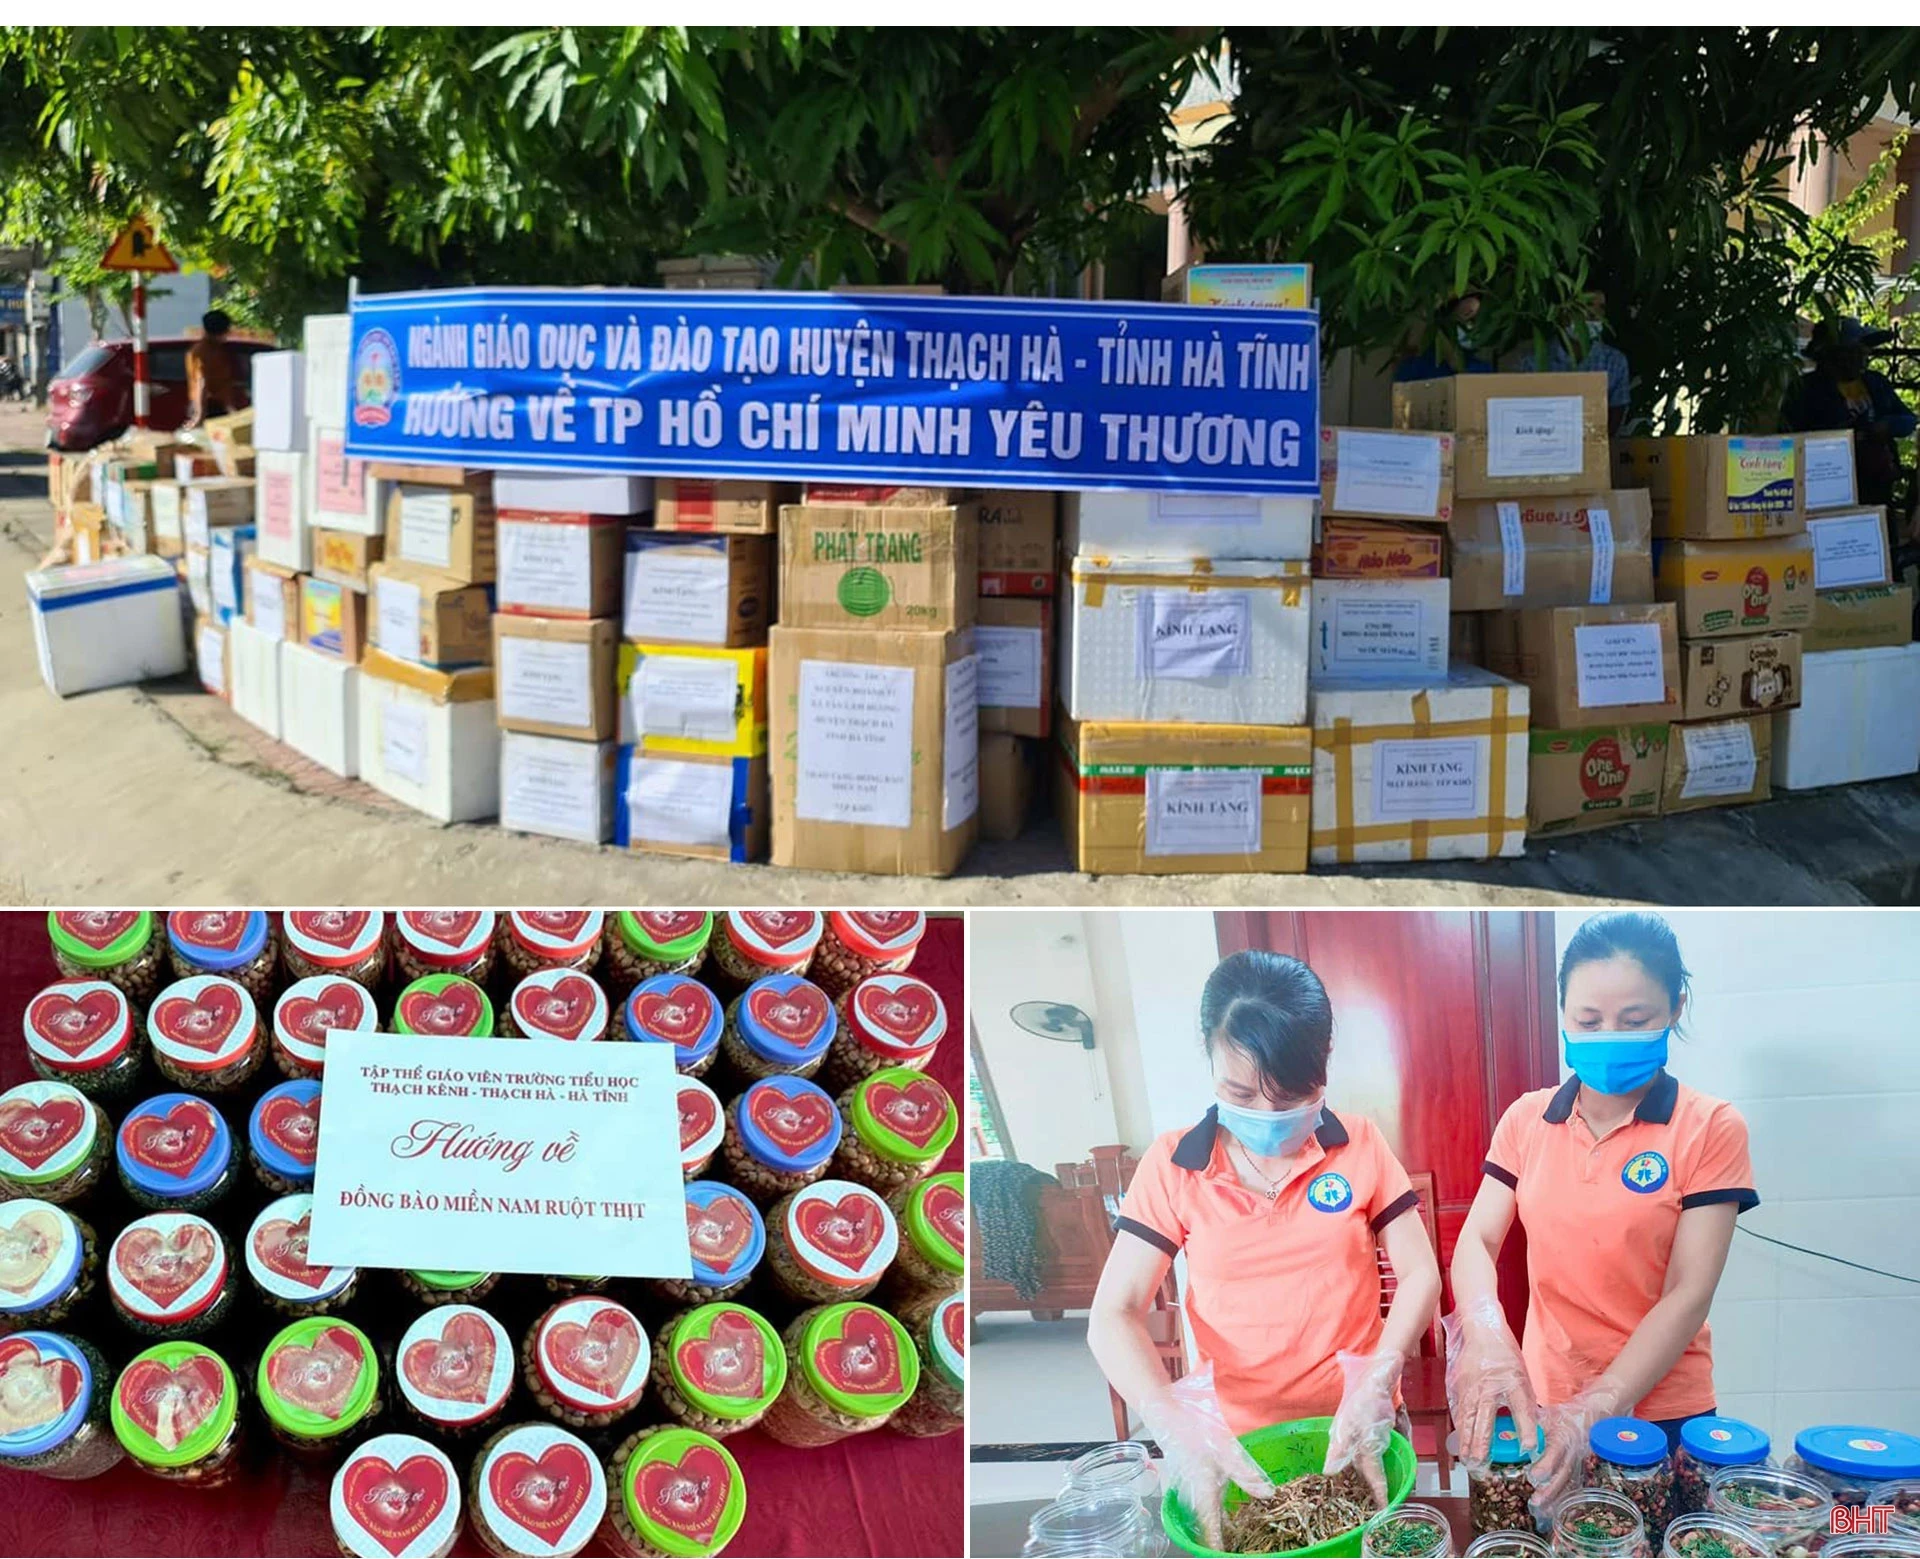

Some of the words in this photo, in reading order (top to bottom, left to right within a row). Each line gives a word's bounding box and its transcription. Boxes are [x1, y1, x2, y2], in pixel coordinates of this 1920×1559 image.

[408, 315, 469, 369] NGÀNH
[473, 313, 531, 369] GIÁO
[605, 314, 642, 373] VÀ
[651, 314, 713, 374] ĐÀO
[722, 325, 779, 385] TẠO
[790, 318, 895, 388] HUYỆN
[906, 330, 1011, 391] THẠCH
[1021, 325, 1064, 383] HÀ
[1099, 319, 1172, 387] TỈNH
[1183, 330, 1225, 389] HÀ
[1237, 333, 1310, 391] TĨNH
[402, 382, 515, 441] HƯỚNG
[528, 379, 578, 443] VỀ
[589, 396, 644, 445] TP
[659, 384, 723, 449] HỒ
[739, 392, 821, 452] CHÍ
[836, 403, 971, 456] MINH
[988, 400, 1083, 461] YÊU
[1100, 411, 1301, 468] THƯƠNG
[864, 530, 923, 564] TRANG
[906, 604, 938, 619] 20kg
[360, 1065, 391, 1081] TẬP
[393, 1065, 423, 1081] THỂ
[426, 1067, 464, 1083] GIÁO
[467, 1067, 502, 1084] VIÊN
[505, 1070, 566, 1087] TRƯỜNG
[568, 1070, 604, 1089] TIỂU
[607, 1075, 640, 1089] HỌC
[370, 1081, 424, 1098] THẠCH
[426, 1080, 470, 1098] KÊNH
[481, 1085, 533, 1101] THẠCH
[534, 1085, 557, 1101] HÀ
[568, 1087, 593, 1102] HÀ
[596, 1089, 629, 1103] TĨNH
[390, 1119, 535, 1173] Hướng
[541, 1130, 580, 1163] về
[339, 1183, 395, 1210] ĐỒNG
[400, 1189, 440, 1211] BÀO
[443, 1187, 494, 1213] MIỀN
[498, 1197, 542, 1215] NAM
[545, 1196, 597, 1219] RUỘT
[599, 1200, 646, 1220] THỊT
